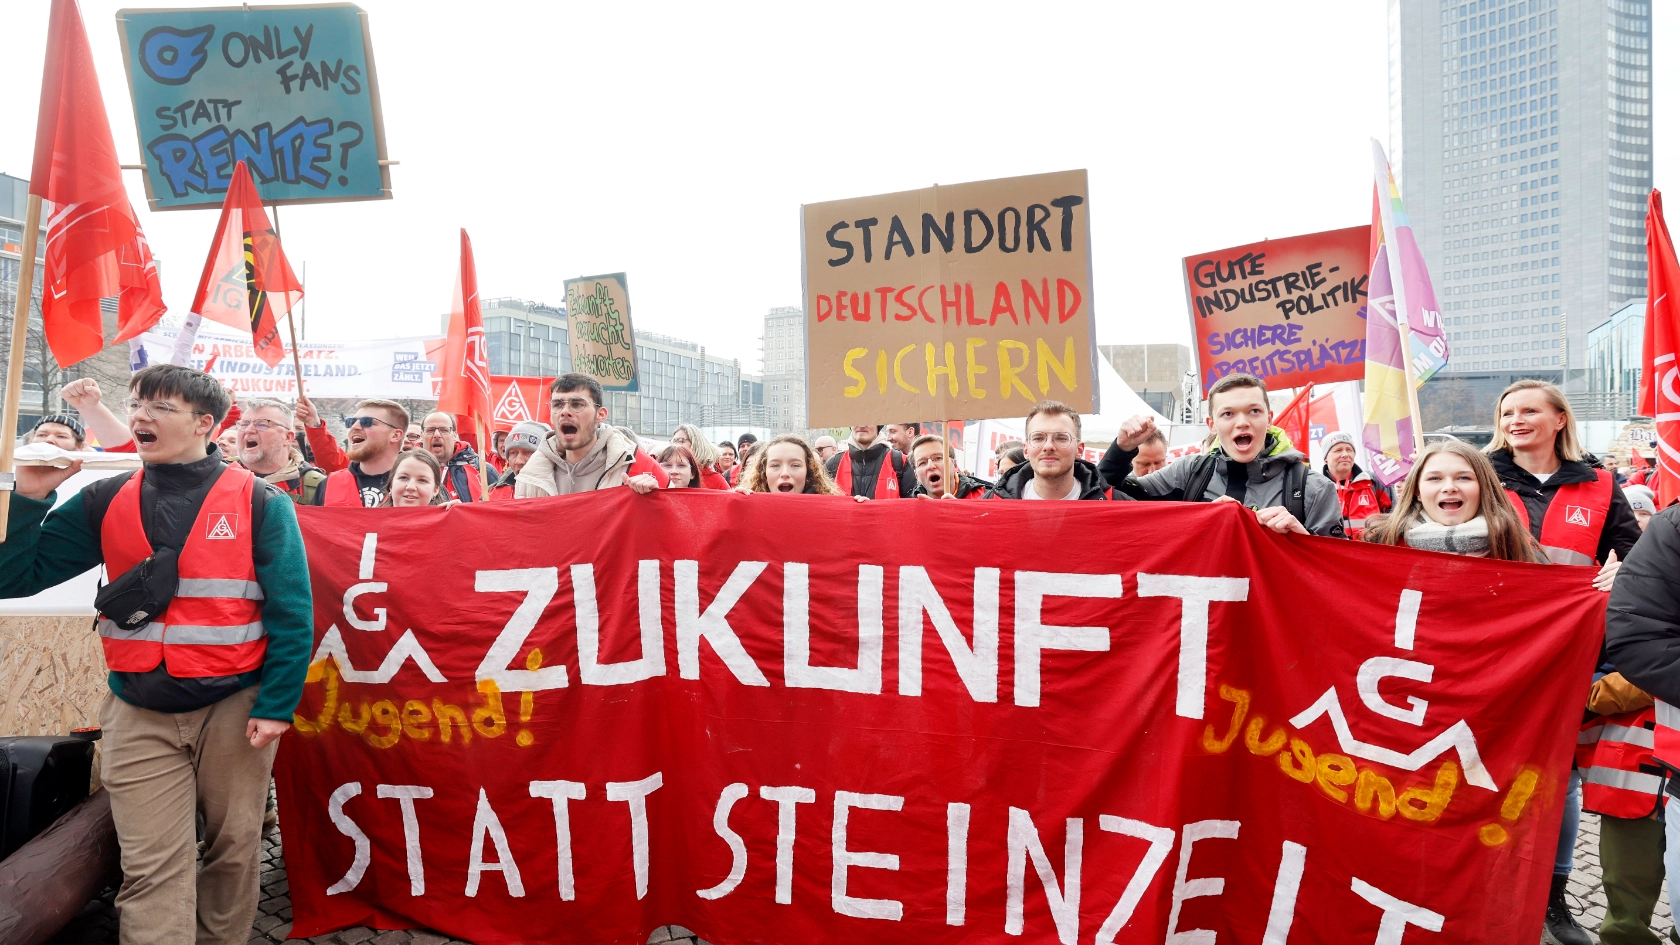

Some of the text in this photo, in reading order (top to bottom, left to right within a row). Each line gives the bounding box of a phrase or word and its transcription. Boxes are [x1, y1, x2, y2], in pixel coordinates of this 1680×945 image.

[222, 23, 313, 68] ONLY
[276, 58, 361, 95] FANS
[156, 98, 242, 131] STATT
[147, 115, 364, 197] RENTE?
[826, 195, 1084, 267] STANDORT
[1194, 252, 1265, 288] GUTE
[1195, 262, 1340, 318] INDUSTRIE-
[816, 277, 1082, 327] DEUTSCHLAND
[1276, 274, 1368, 320] POLITIK
[1207, 323, 1303, 355] SICHERE
[843, 336, 1078, 403] SICHERN
[475, 559, 1250, 720] ZUKUNFT
[326, 772, 1445, 945] STATT STEINZEIT
